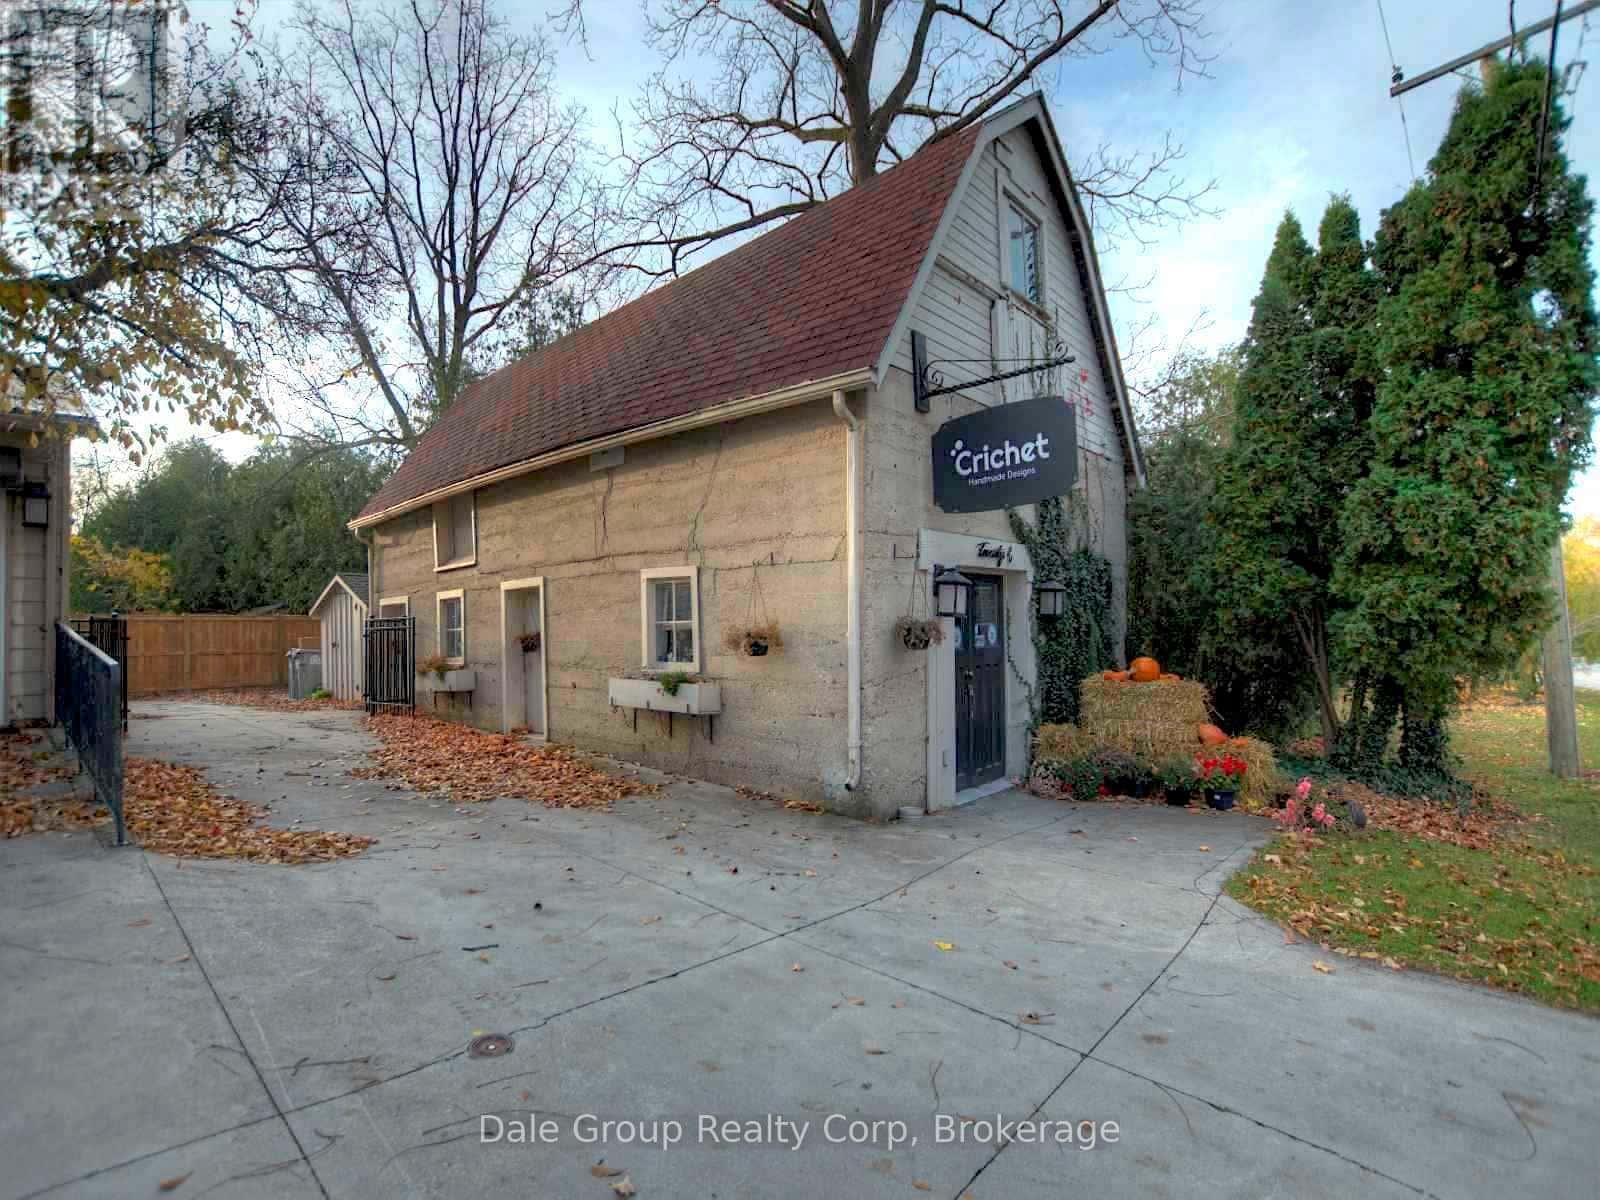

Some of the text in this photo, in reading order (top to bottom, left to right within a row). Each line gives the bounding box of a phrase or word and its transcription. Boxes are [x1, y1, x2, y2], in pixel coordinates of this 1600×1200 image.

[954, 432, 1049, 475] Crichet
[968, 466, 1036, 487] Handmade Designs
